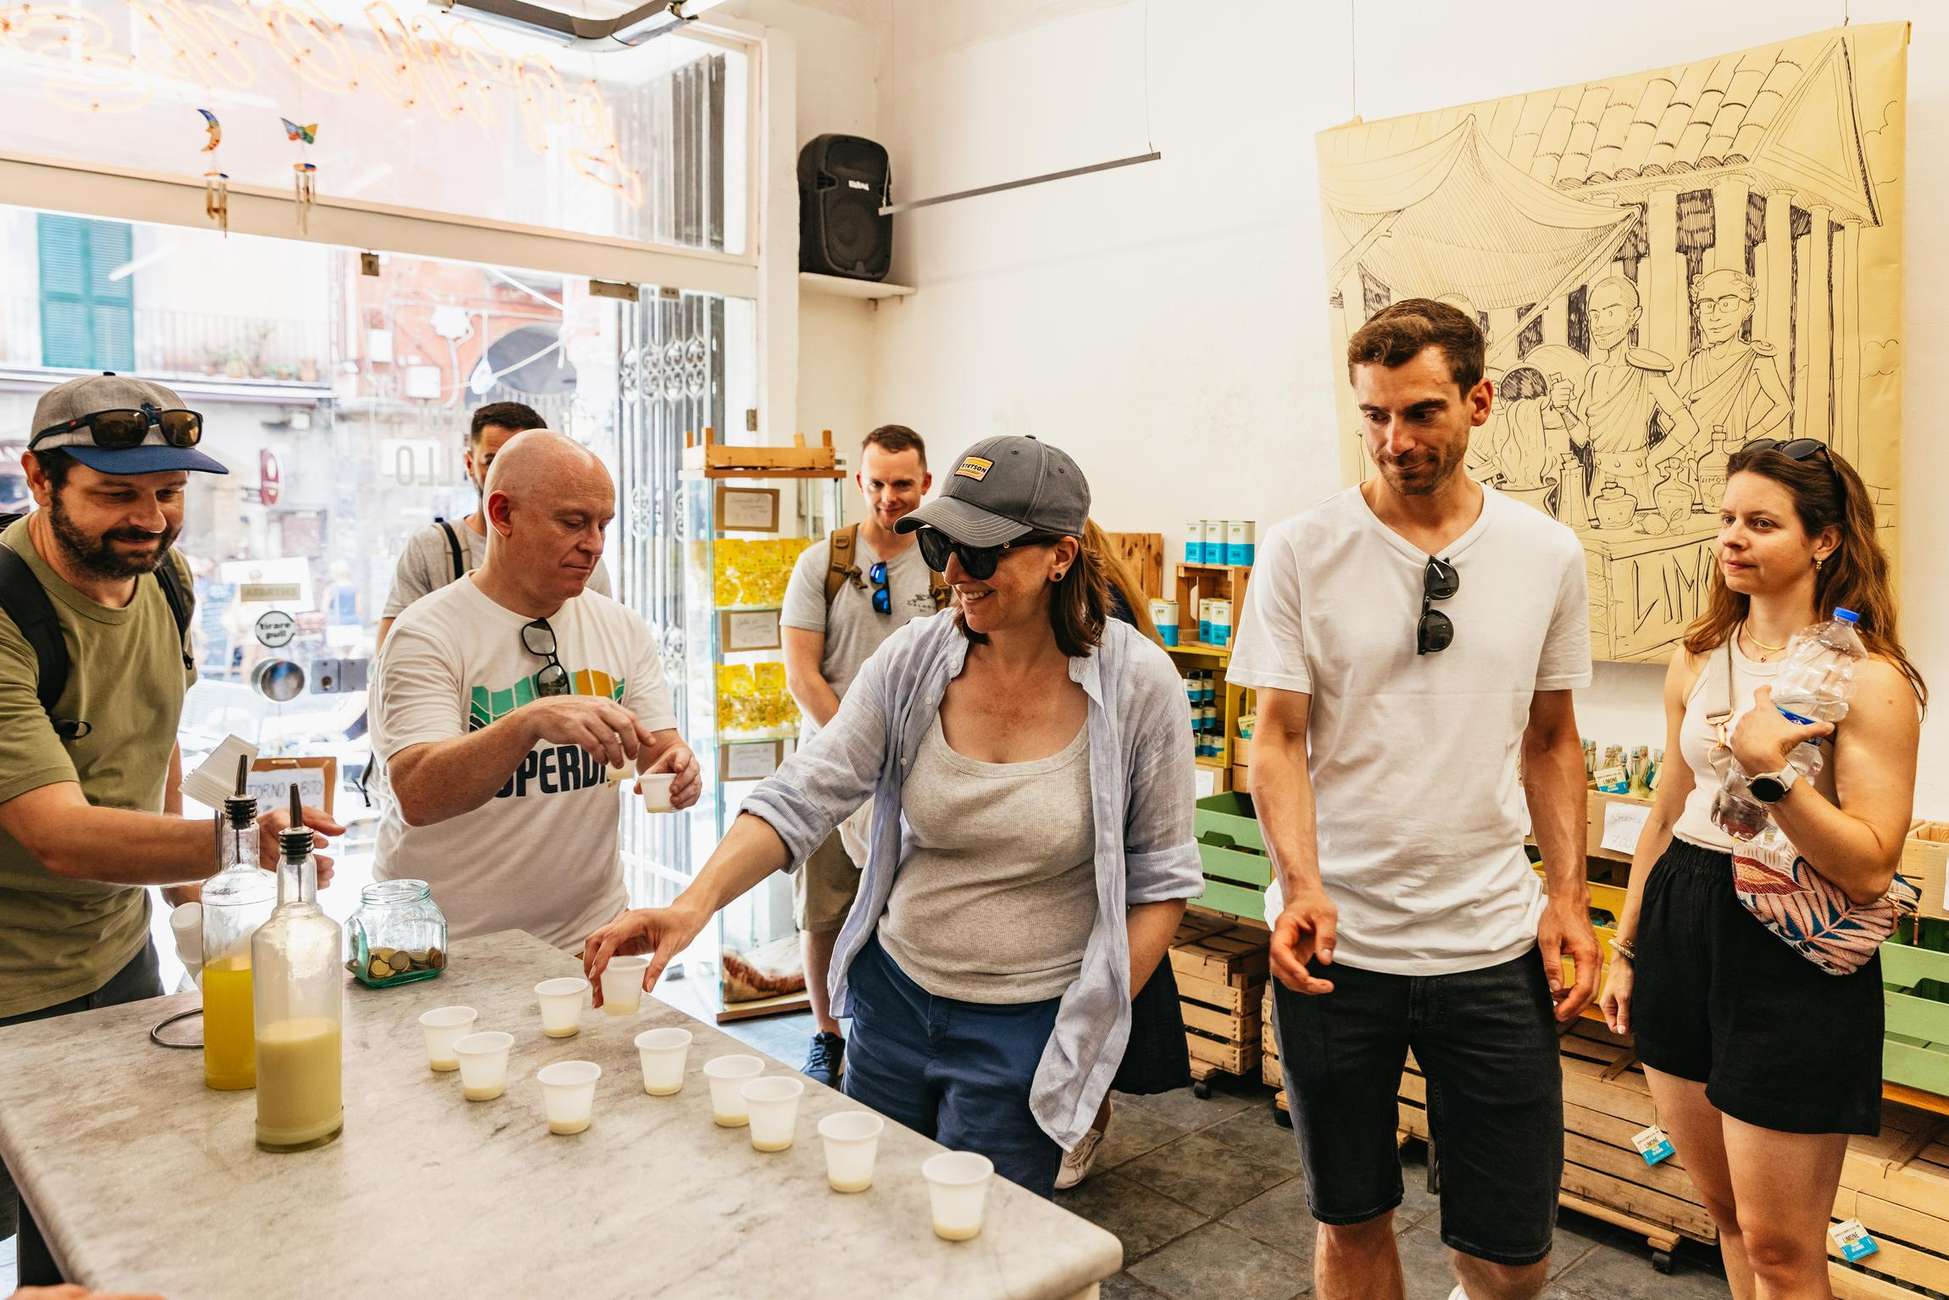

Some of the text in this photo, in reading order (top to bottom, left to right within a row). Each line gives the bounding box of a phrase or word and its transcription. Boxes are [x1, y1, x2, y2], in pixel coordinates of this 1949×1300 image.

[961, 463, 988, 473] STETSON
[259, 622, 291, 631] tirare
[265, 630, 287, 640] pull
